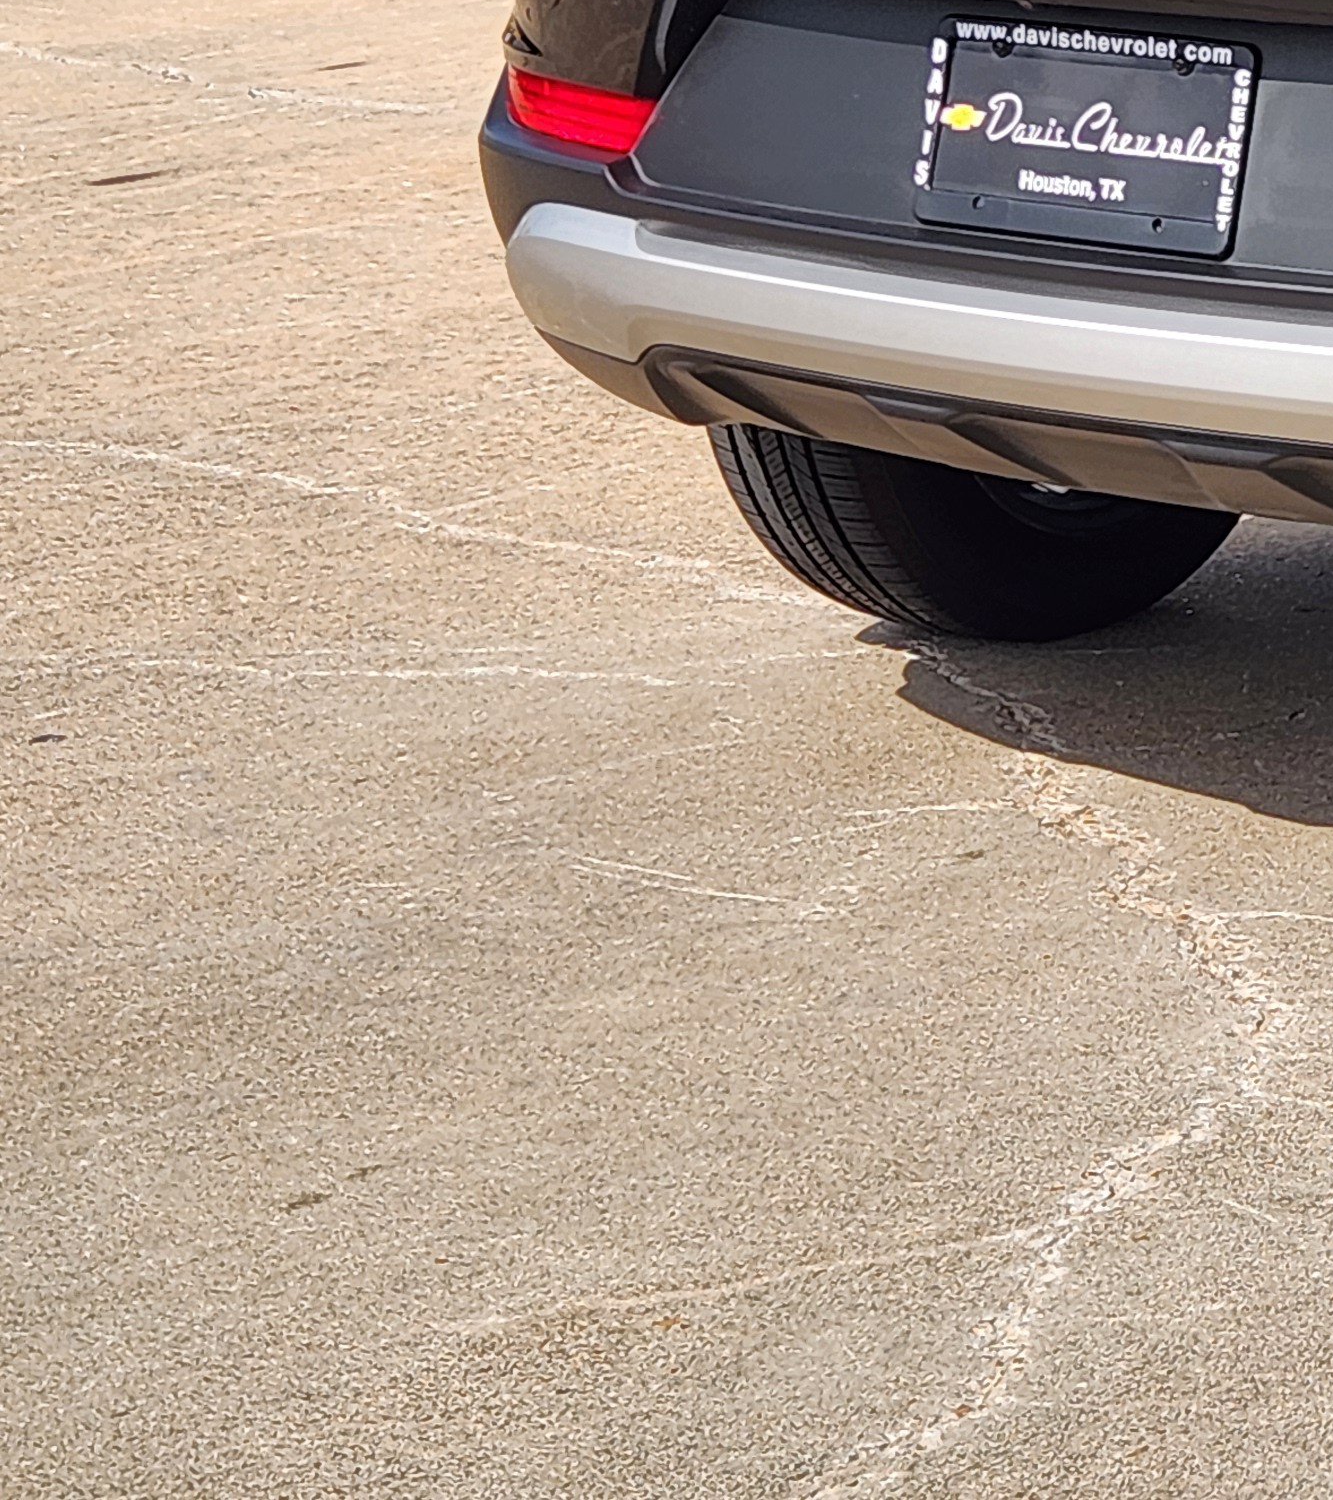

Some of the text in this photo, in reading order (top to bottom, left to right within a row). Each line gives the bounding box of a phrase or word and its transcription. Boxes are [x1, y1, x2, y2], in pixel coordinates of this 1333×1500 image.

[955, 21, 1233, 66] www.davischevroletcom
[985, 92, 1229, 165] Davis Chevrolet
[1018, 168, 1127, 202] Houston, TX
